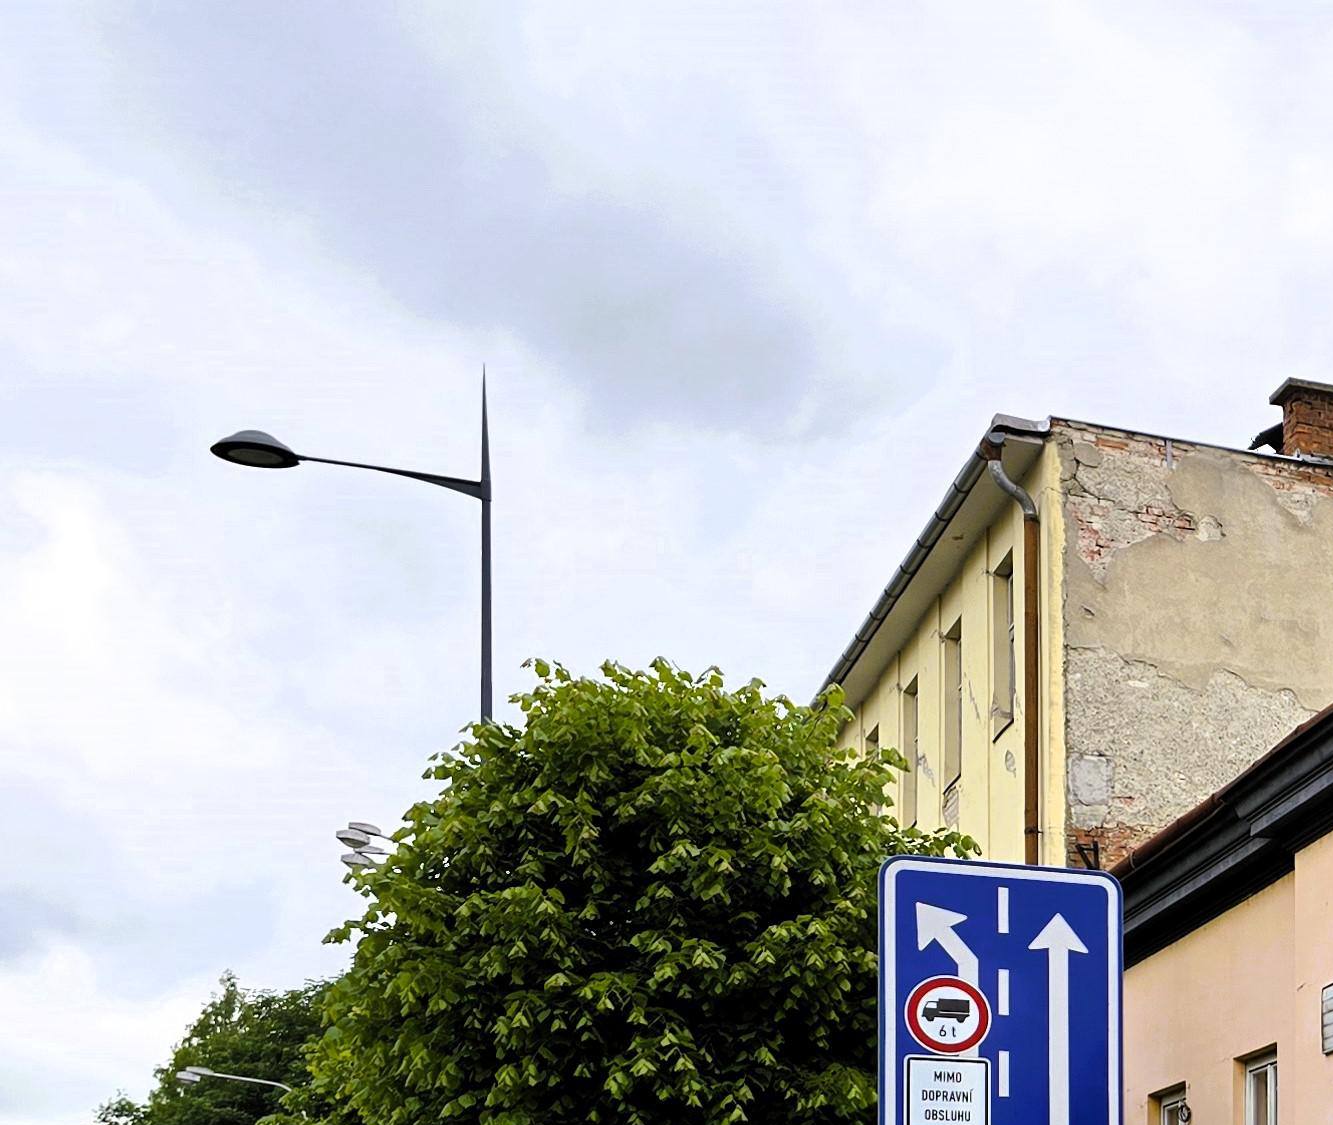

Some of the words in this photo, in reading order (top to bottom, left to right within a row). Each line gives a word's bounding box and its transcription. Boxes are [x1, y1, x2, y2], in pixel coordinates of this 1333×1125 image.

[939, 1024, 947, 1037] 6
[951, 1026, 957, 1038] t
[934, 1071, 962, 1083] MIMO
[921, 1088, 974, 1103] DOPRAVNÍ
[924, 1109, 971, 1122] OBSLUHU
